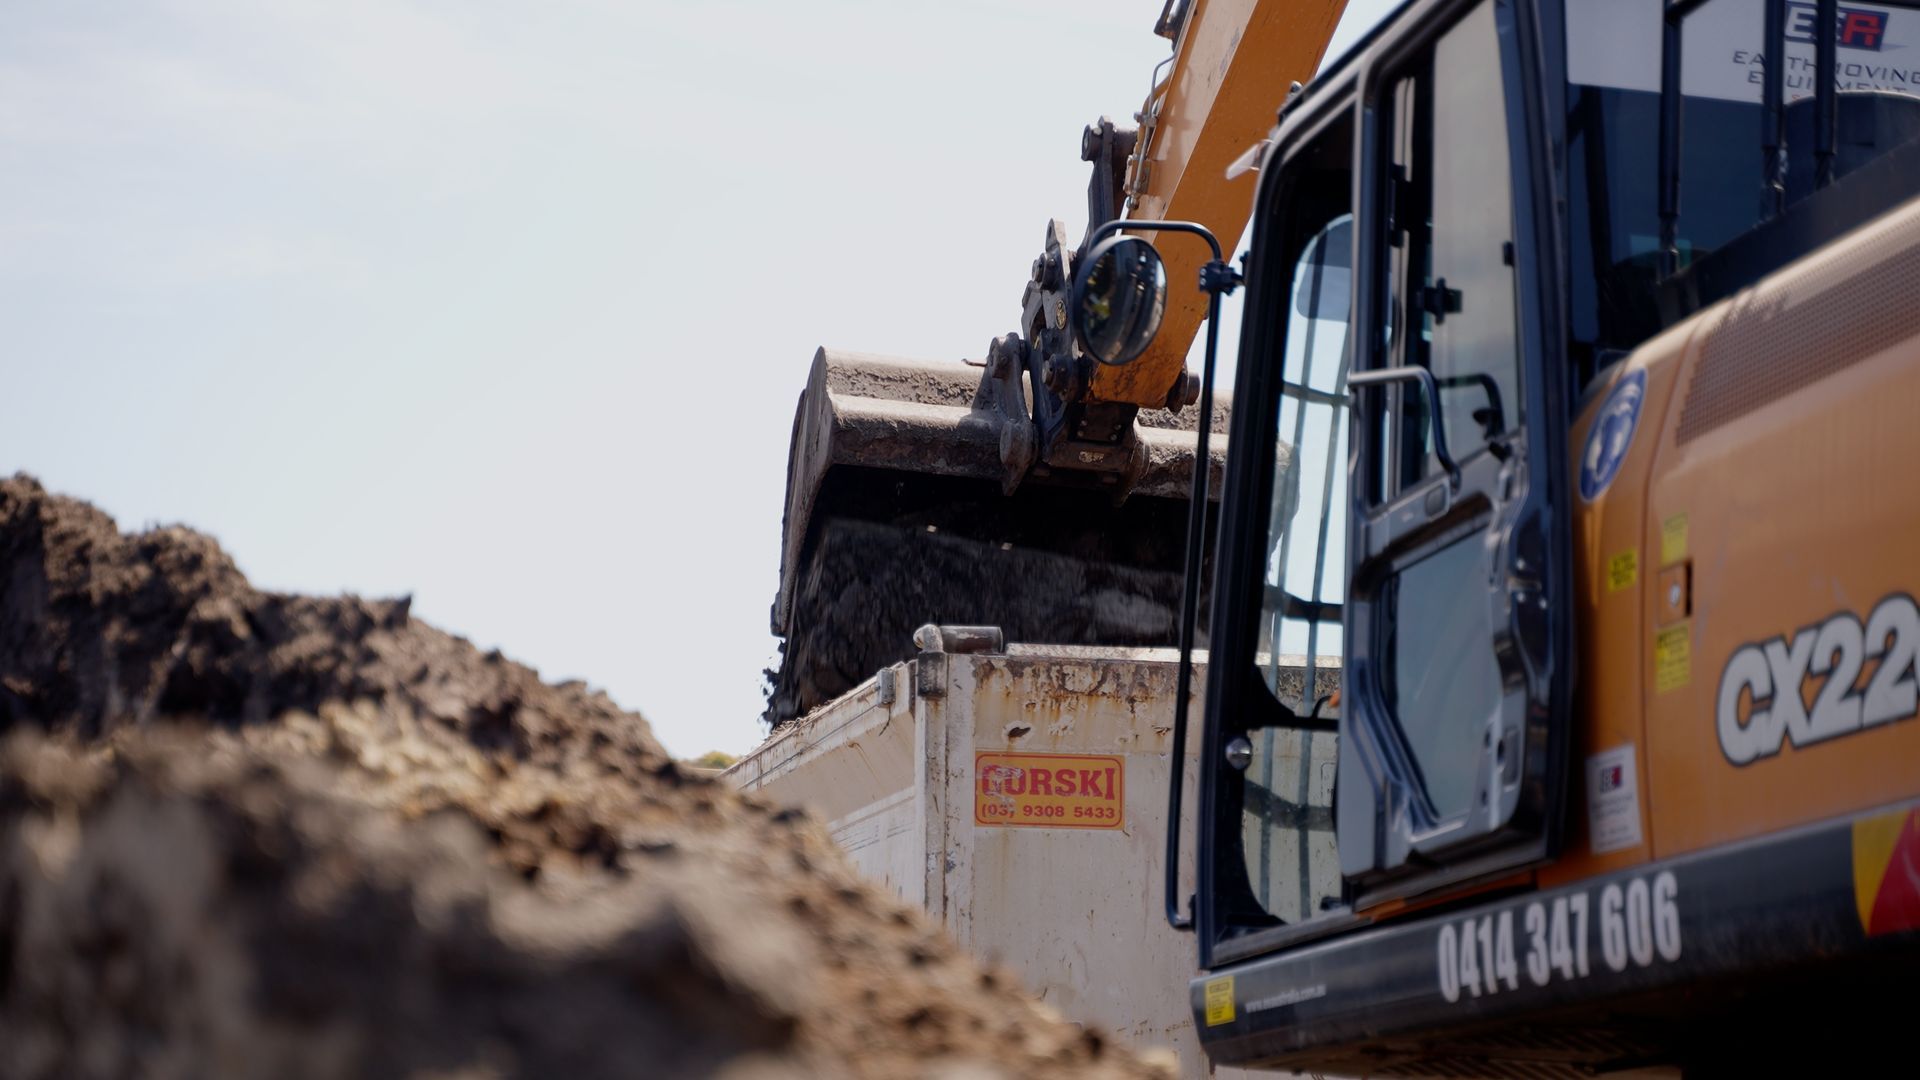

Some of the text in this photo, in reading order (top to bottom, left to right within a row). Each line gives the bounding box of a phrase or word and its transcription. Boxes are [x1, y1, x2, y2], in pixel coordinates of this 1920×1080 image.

[1732, 50, 1920, 84] EATHOVING
[1716, 592, 1920, 767] CX22
[982, 765, 1115, 800] GORSKI
[1023, 805, 1065, 817] 9308
[1074, 806, 1115, 819] 5433
[1438, 870, 1682, 1003] 0414 347 606
